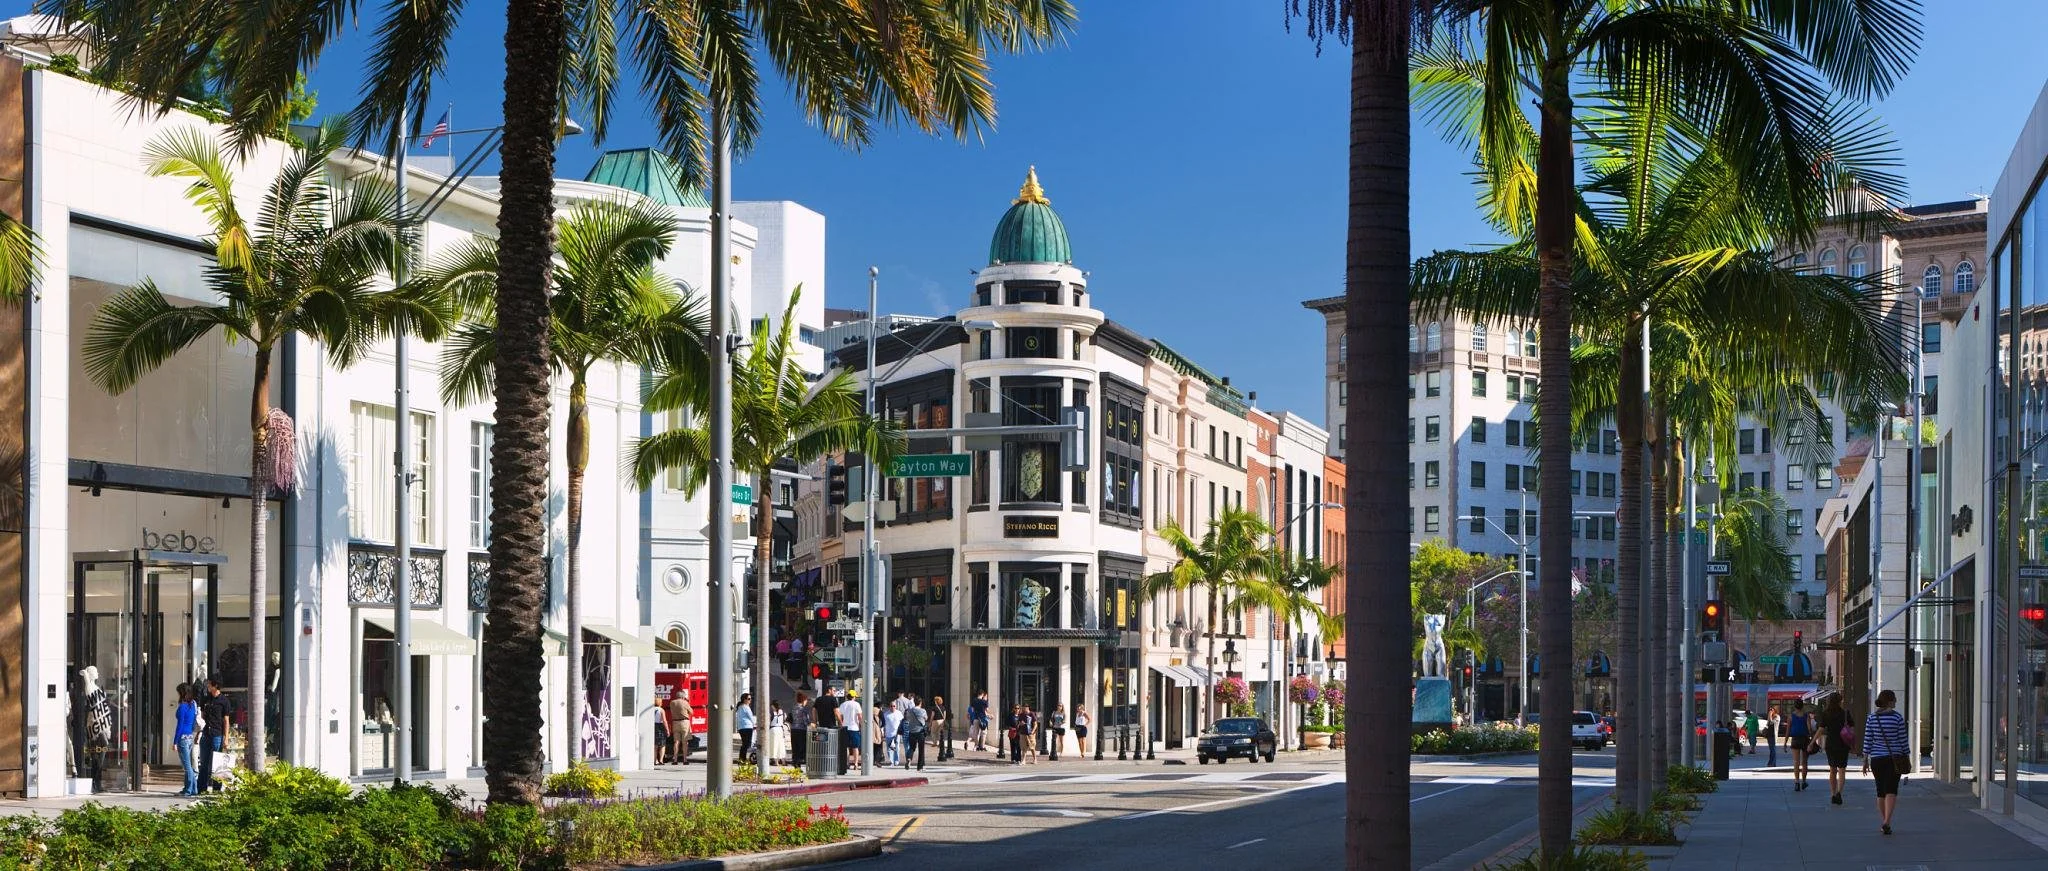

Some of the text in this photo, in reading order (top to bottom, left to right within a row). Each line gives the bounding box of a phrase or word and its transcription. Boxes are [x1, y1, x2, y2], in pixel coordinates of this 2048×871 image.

[891, 459, 965, 475] Dayton Way
[1038, 522, 1057, 530] RICCI
[142, 527, 216, 552] bebe
[91, 701, 110, 719] THE
